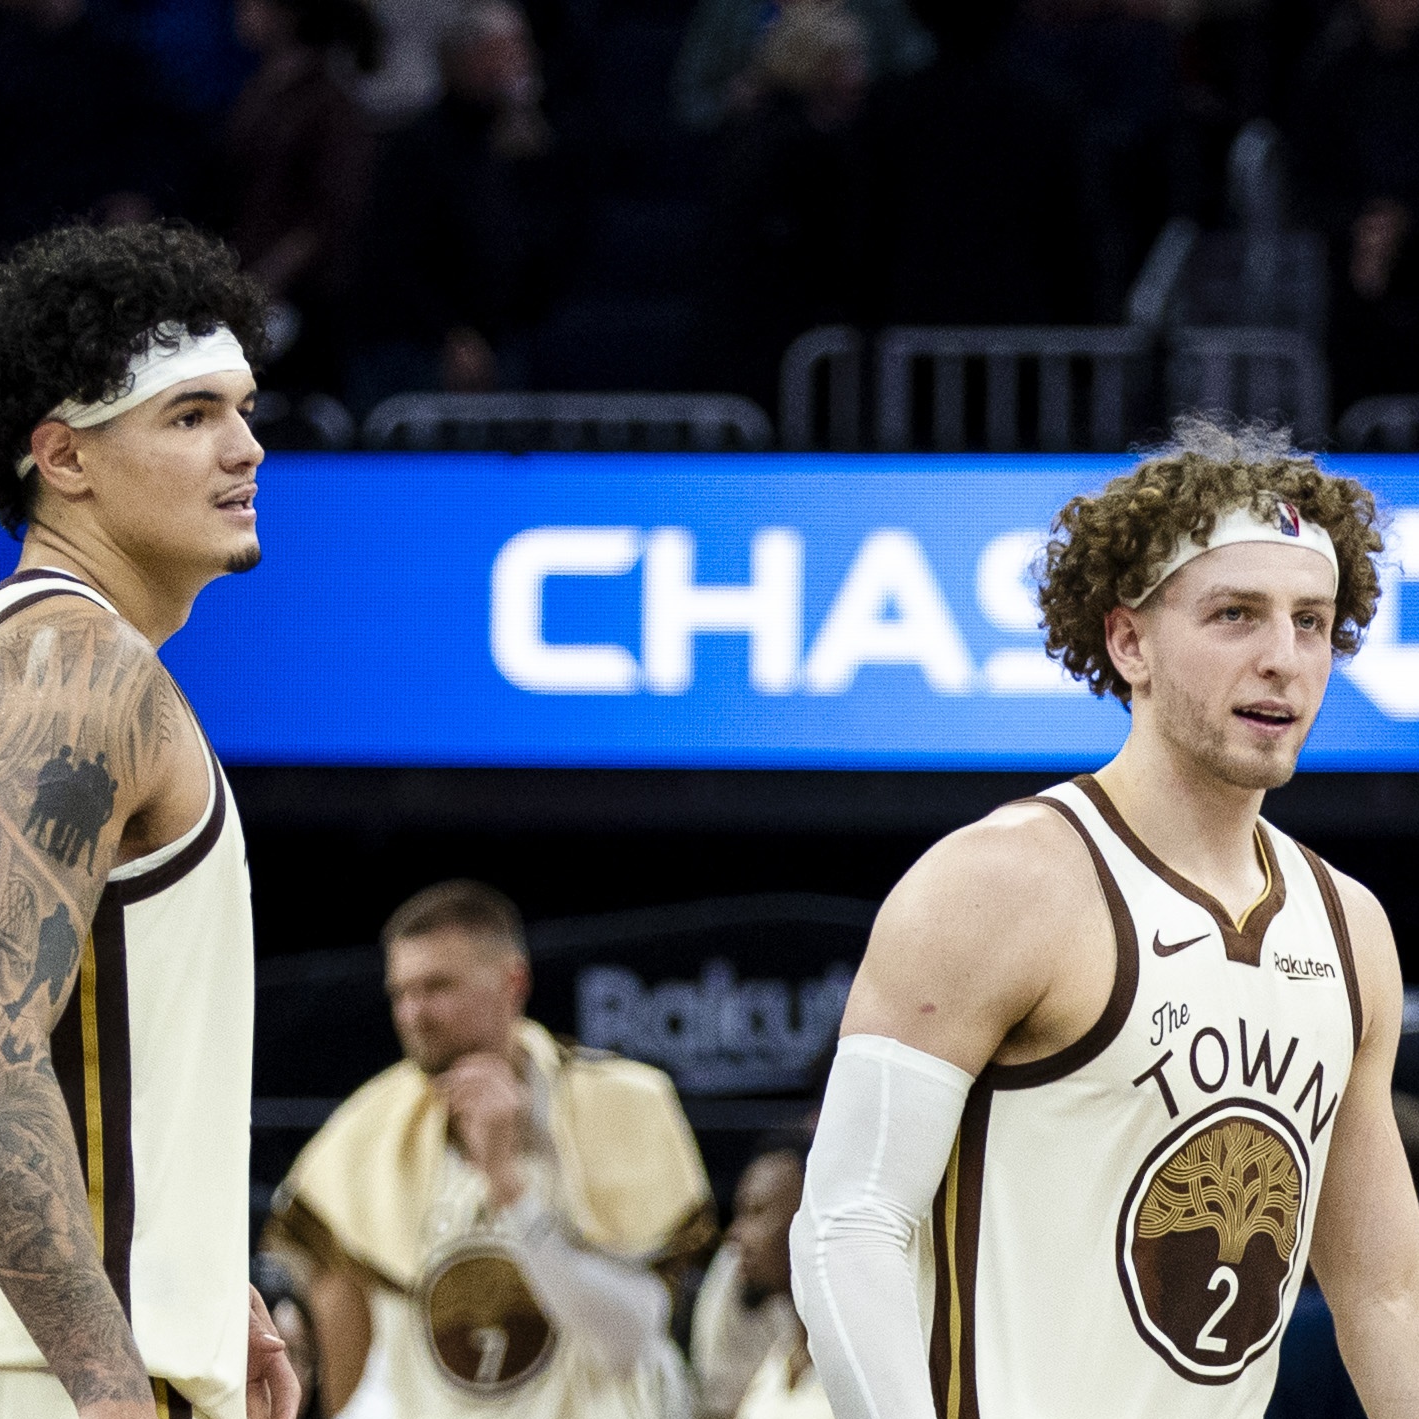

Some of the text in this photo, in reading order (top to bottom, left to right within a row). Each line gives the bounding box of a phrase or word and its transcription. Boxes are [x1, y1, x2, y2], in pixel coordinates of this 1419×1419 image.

[492, 527, 1093, 695] CHAS
[1274, 952, 1336, 980] Rakuten
[1150, 1001, 1191, 1046] The
[1132, 1017, 1338, 1143] TOWN
[1195, 1265, 1239, 1353] 2
